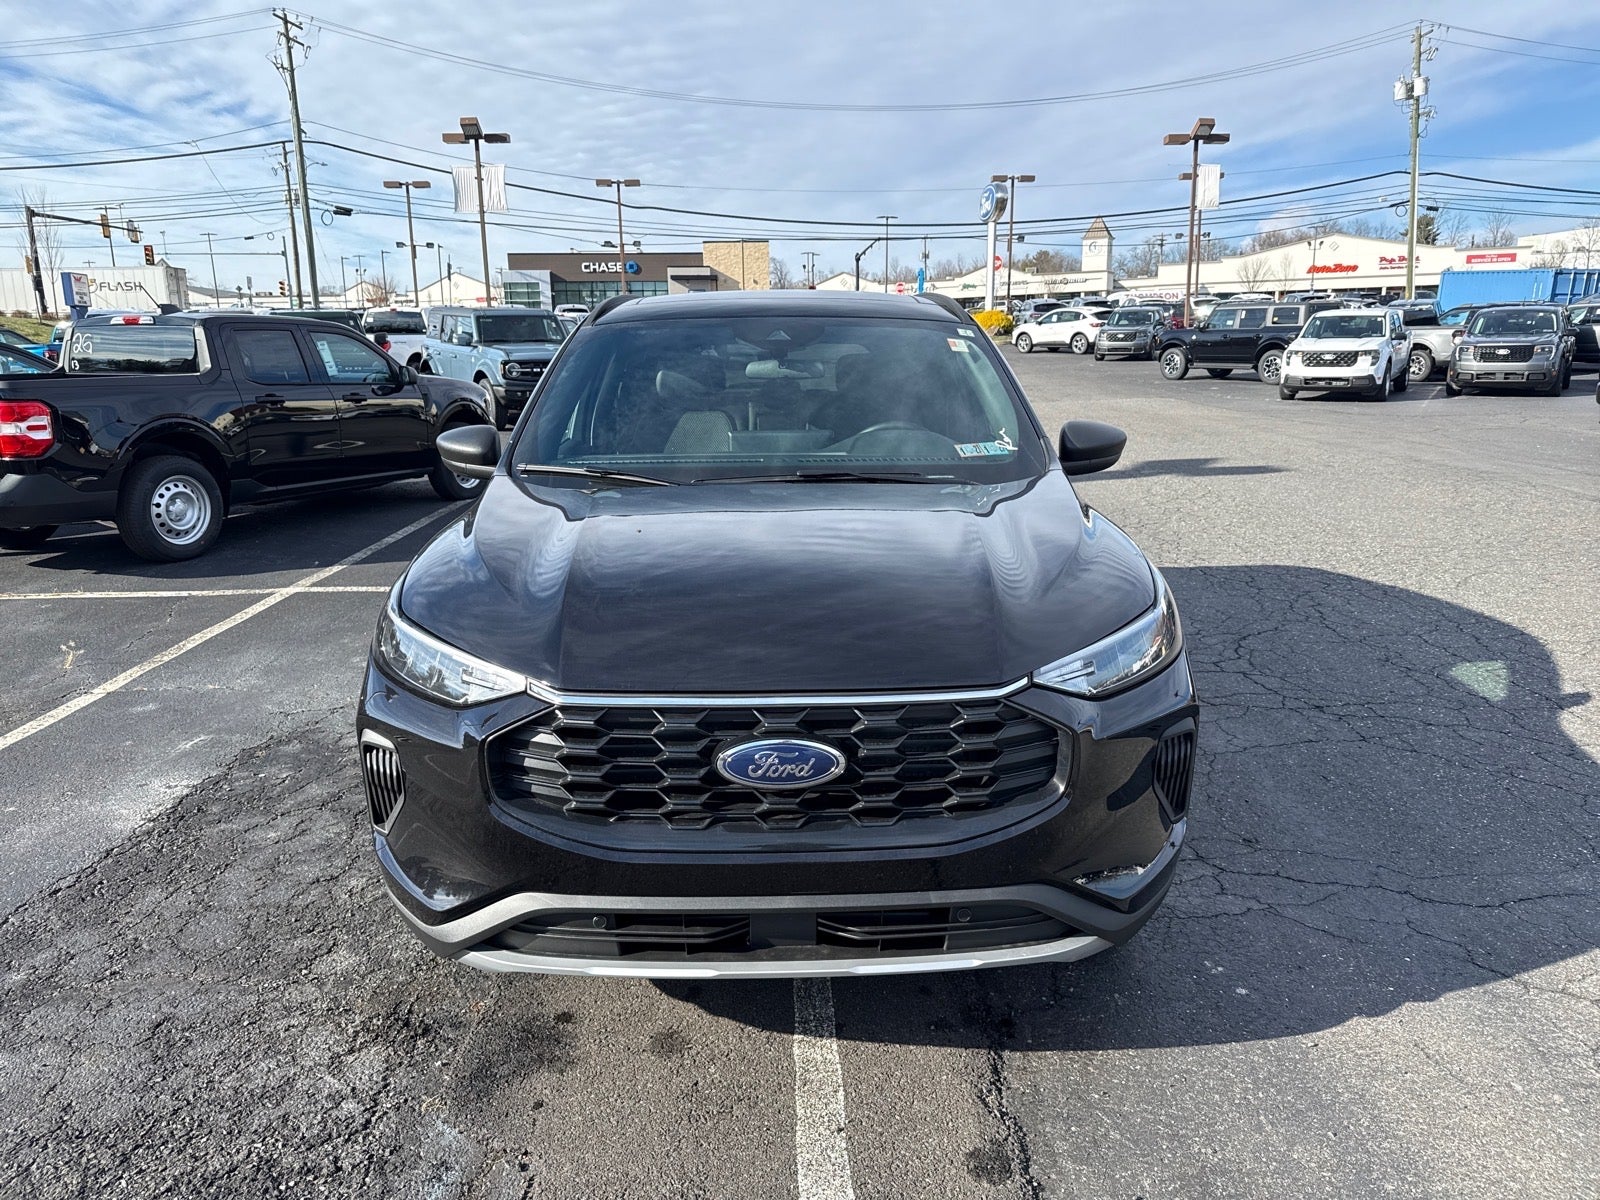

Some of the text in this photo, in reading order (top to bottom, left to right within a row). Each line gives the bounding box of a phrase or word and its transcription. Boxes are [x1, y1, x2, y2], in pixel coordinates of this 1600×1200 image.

[581, 261, 623, 273] CHASE
[1306, 263, 1359, 274] AutoZone
[99, 281, 142, 292] FLASH
[748, 751, 816, 778] Ford
